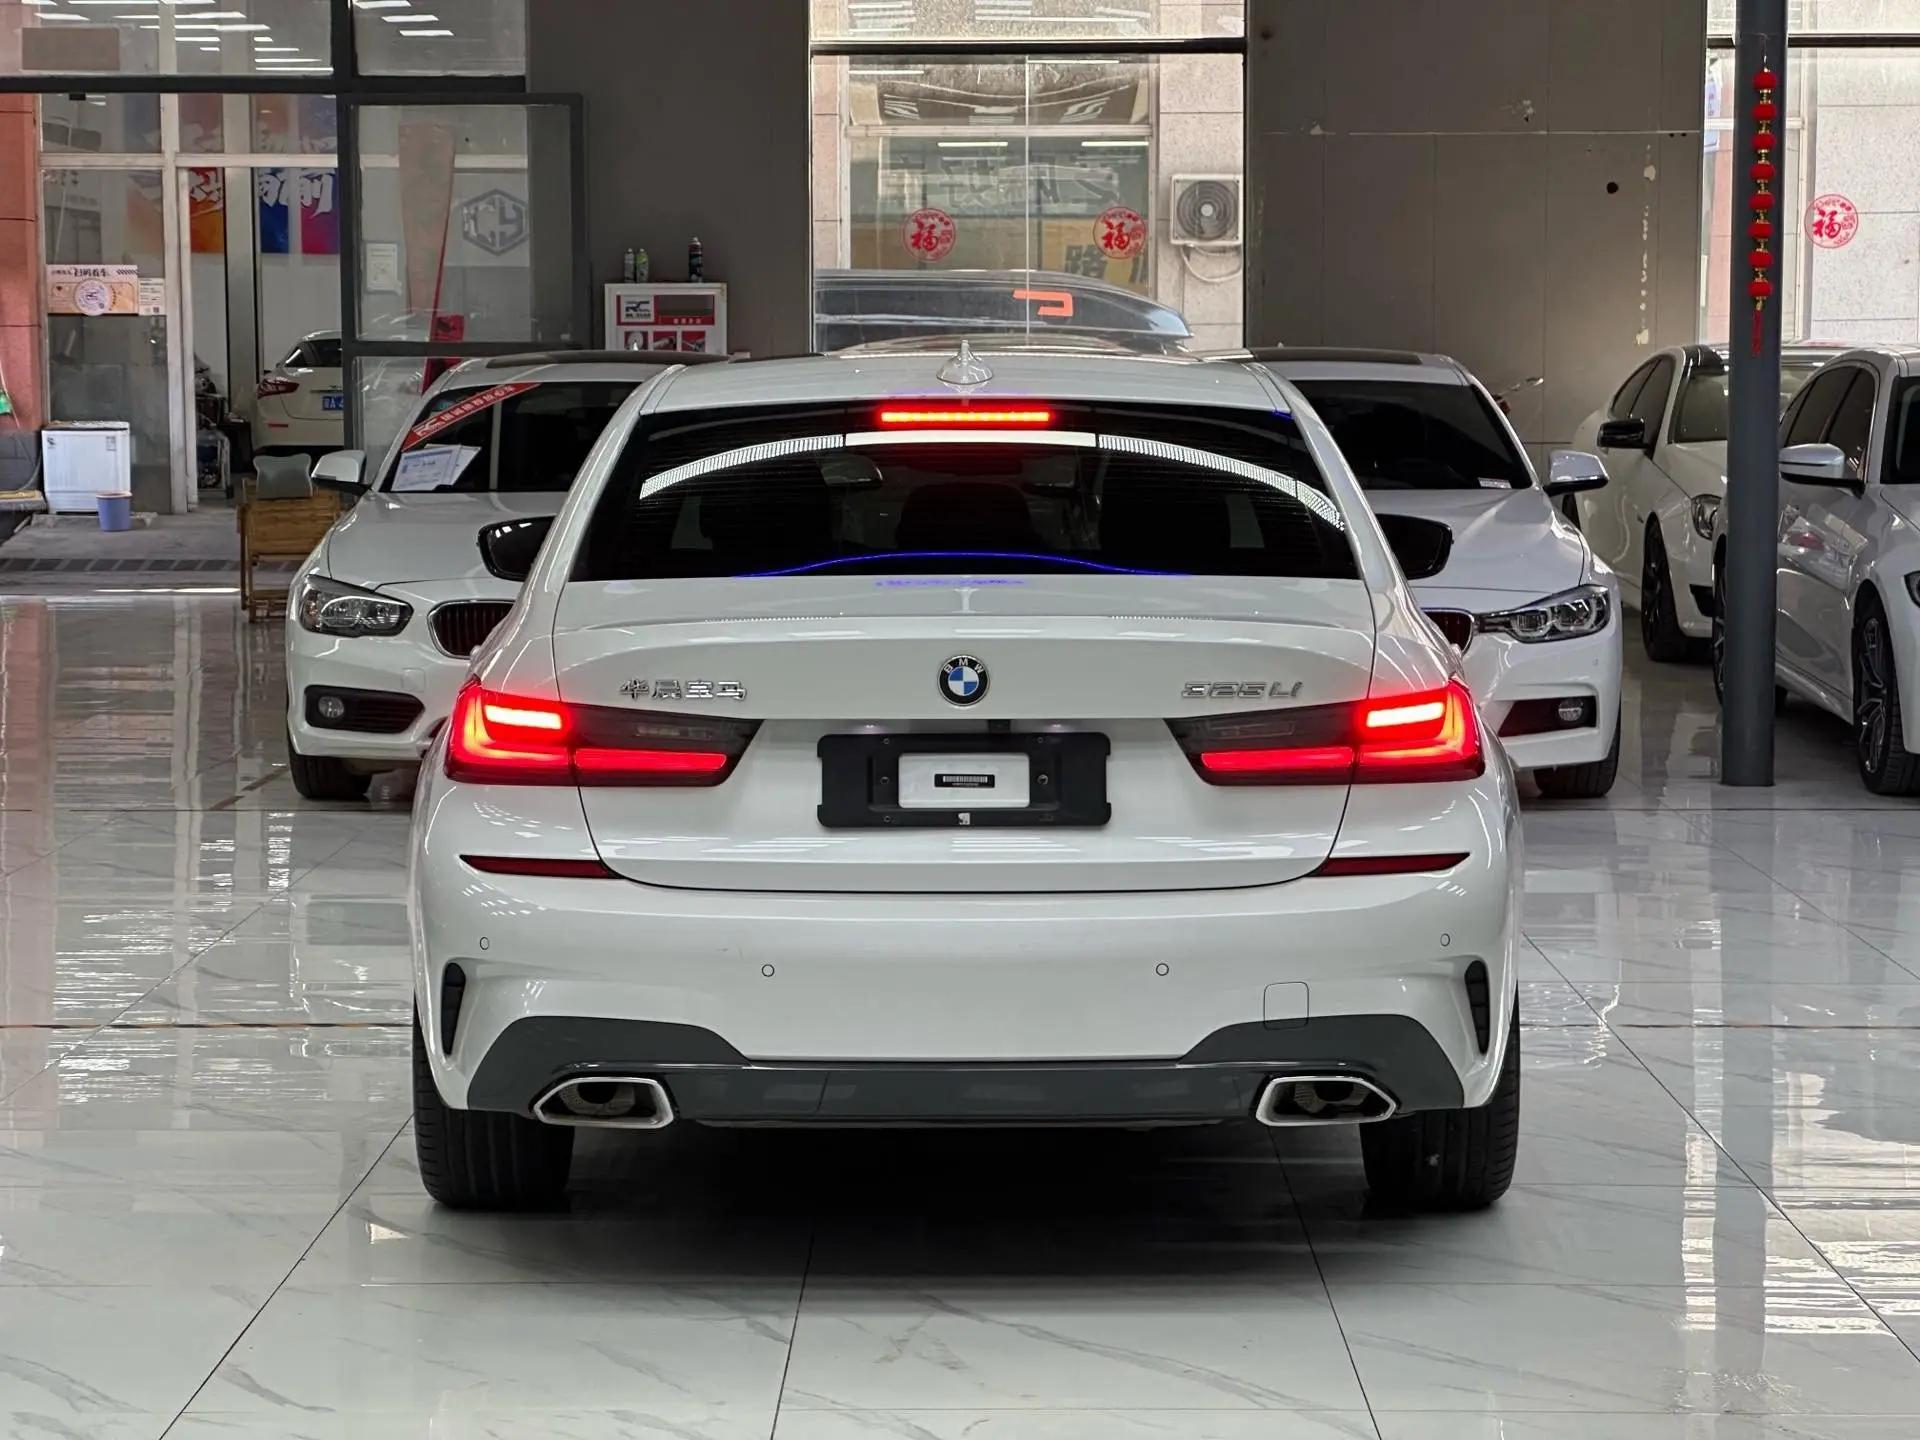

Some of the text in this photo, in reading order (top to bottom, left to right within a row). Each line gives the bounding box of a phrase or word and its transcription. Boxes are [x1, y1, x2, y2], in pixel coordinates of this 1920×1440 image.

[910, 219, 939, 251] 福
[1101, 219, 1131, 250] 福
[1813, 208, 1841, 238] 福
[943, 657, 984, 673] BMW
[620, 678, 746, 701] 华晨宝马
